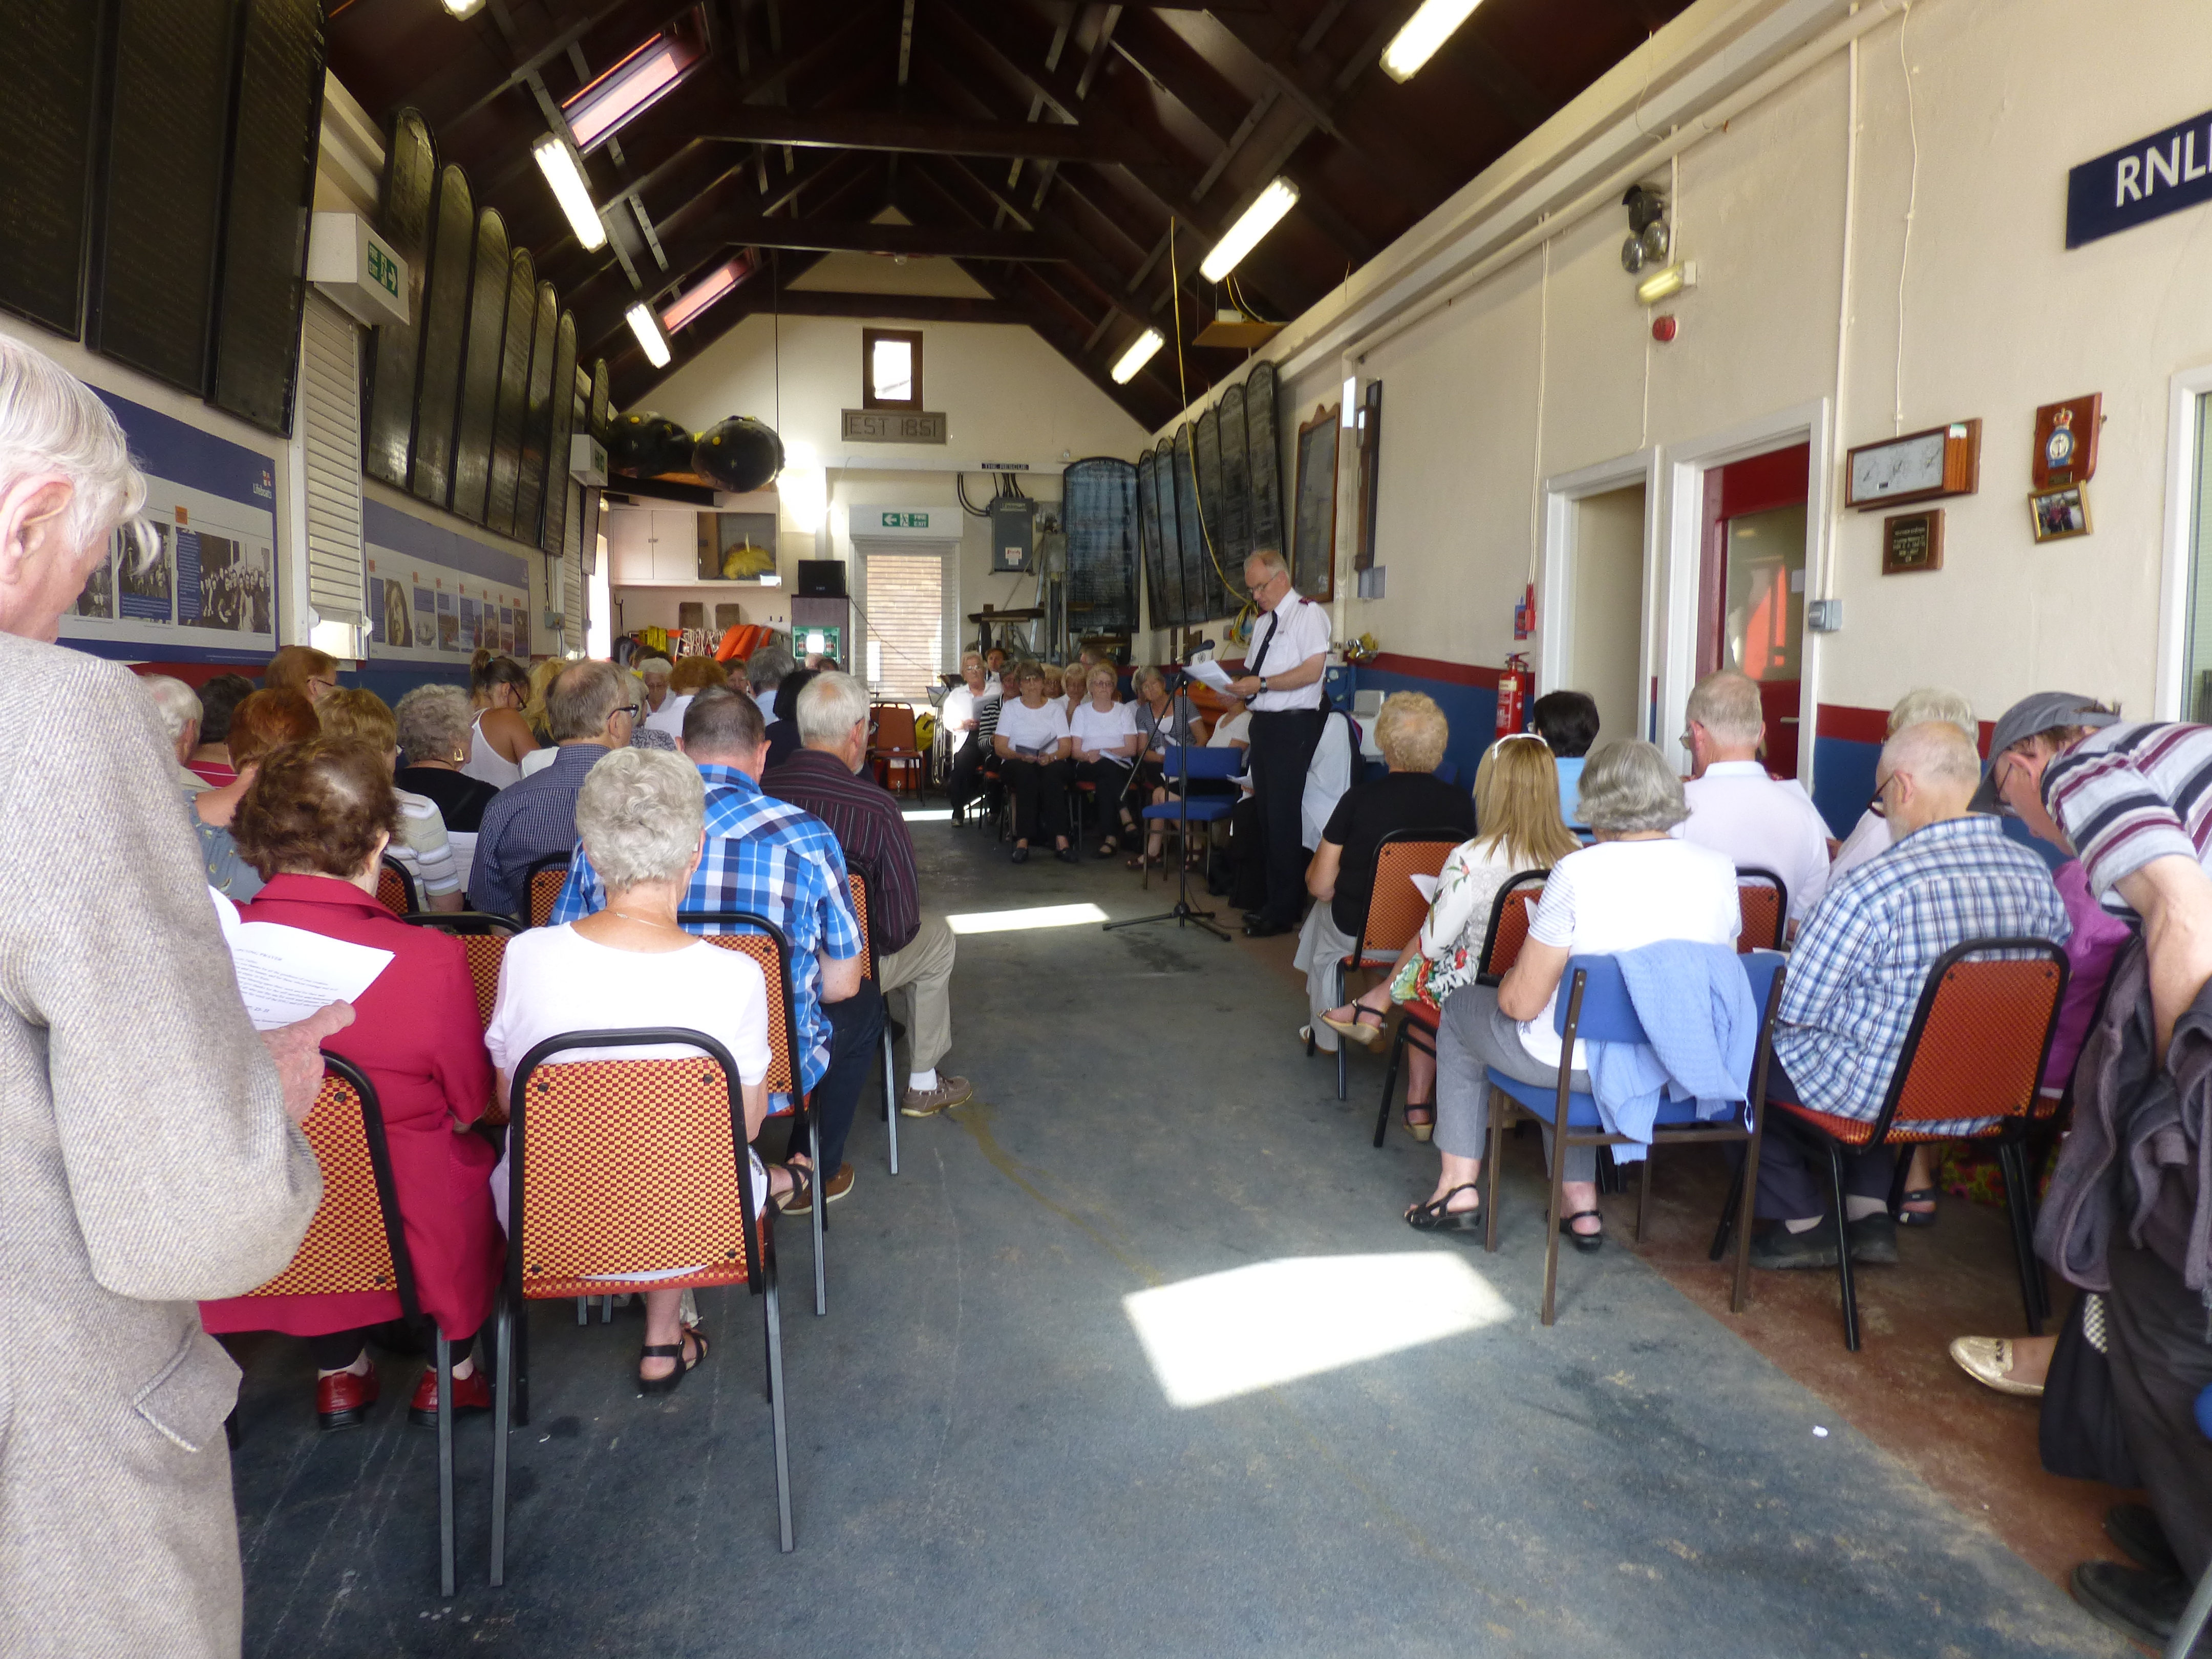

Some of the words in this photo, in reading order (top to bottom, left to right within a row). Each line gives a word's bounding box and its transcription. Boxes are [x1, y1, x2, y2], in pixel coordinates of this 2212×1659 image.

[850, 416, 889, 436] EST
[901, 418, 936, 437] 1851
[253, 483, 272, 499] Lifeboats
